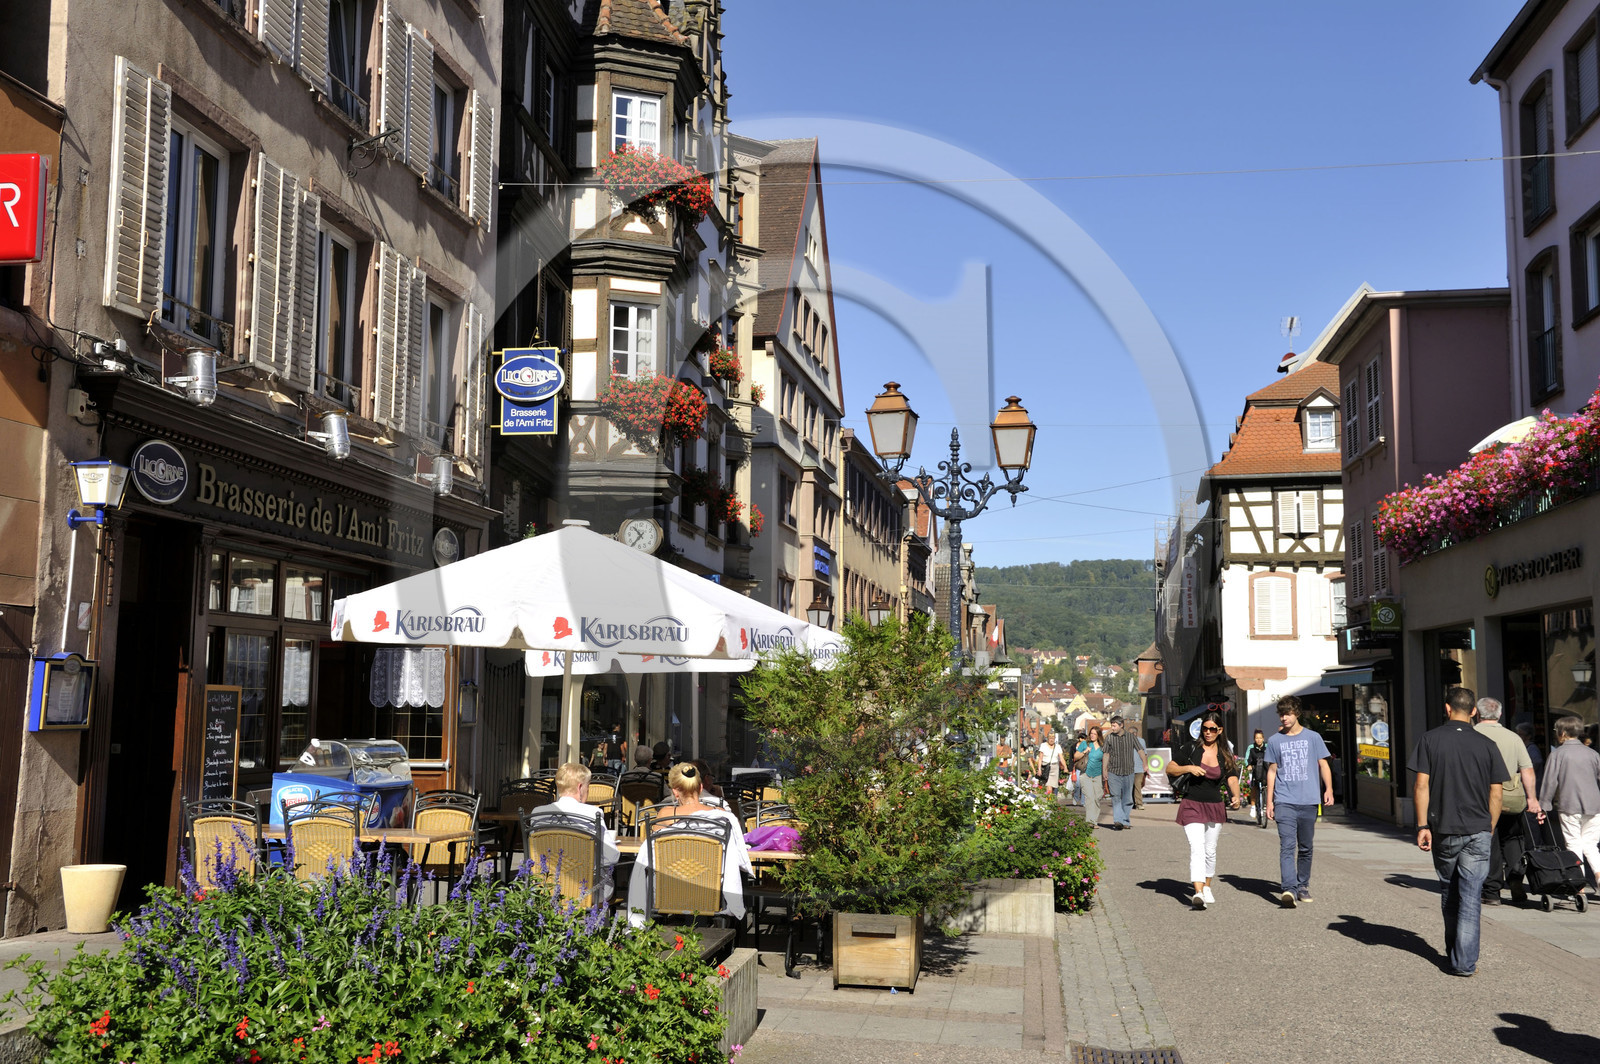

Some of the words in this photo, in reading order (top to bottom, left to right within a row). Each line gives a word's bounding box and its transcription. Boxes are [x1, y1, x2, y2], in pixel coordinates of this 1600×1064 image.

[501, 367, 558, 387] LICORNE
[504, 419, 514, 427] de
[515, 419, 535, 427] l'Ami
[535, 418, 553, 427] Fritz
[510, 408, 547, 417] Brasserie
[139, 454, 184, 486] LICORNE
[196, 462, 306, 529] Brasserie
[310, 497, 333, 535] de
[336, 503, 383, 547] l'Ami
[386, 518, 425, 557] Fritz
[1527, 547, 1583, 580] ROCHER
[395, 605, 486, 640] KARLSBRÄU
[580, 615, 690, 649] KARLSBRÄU
